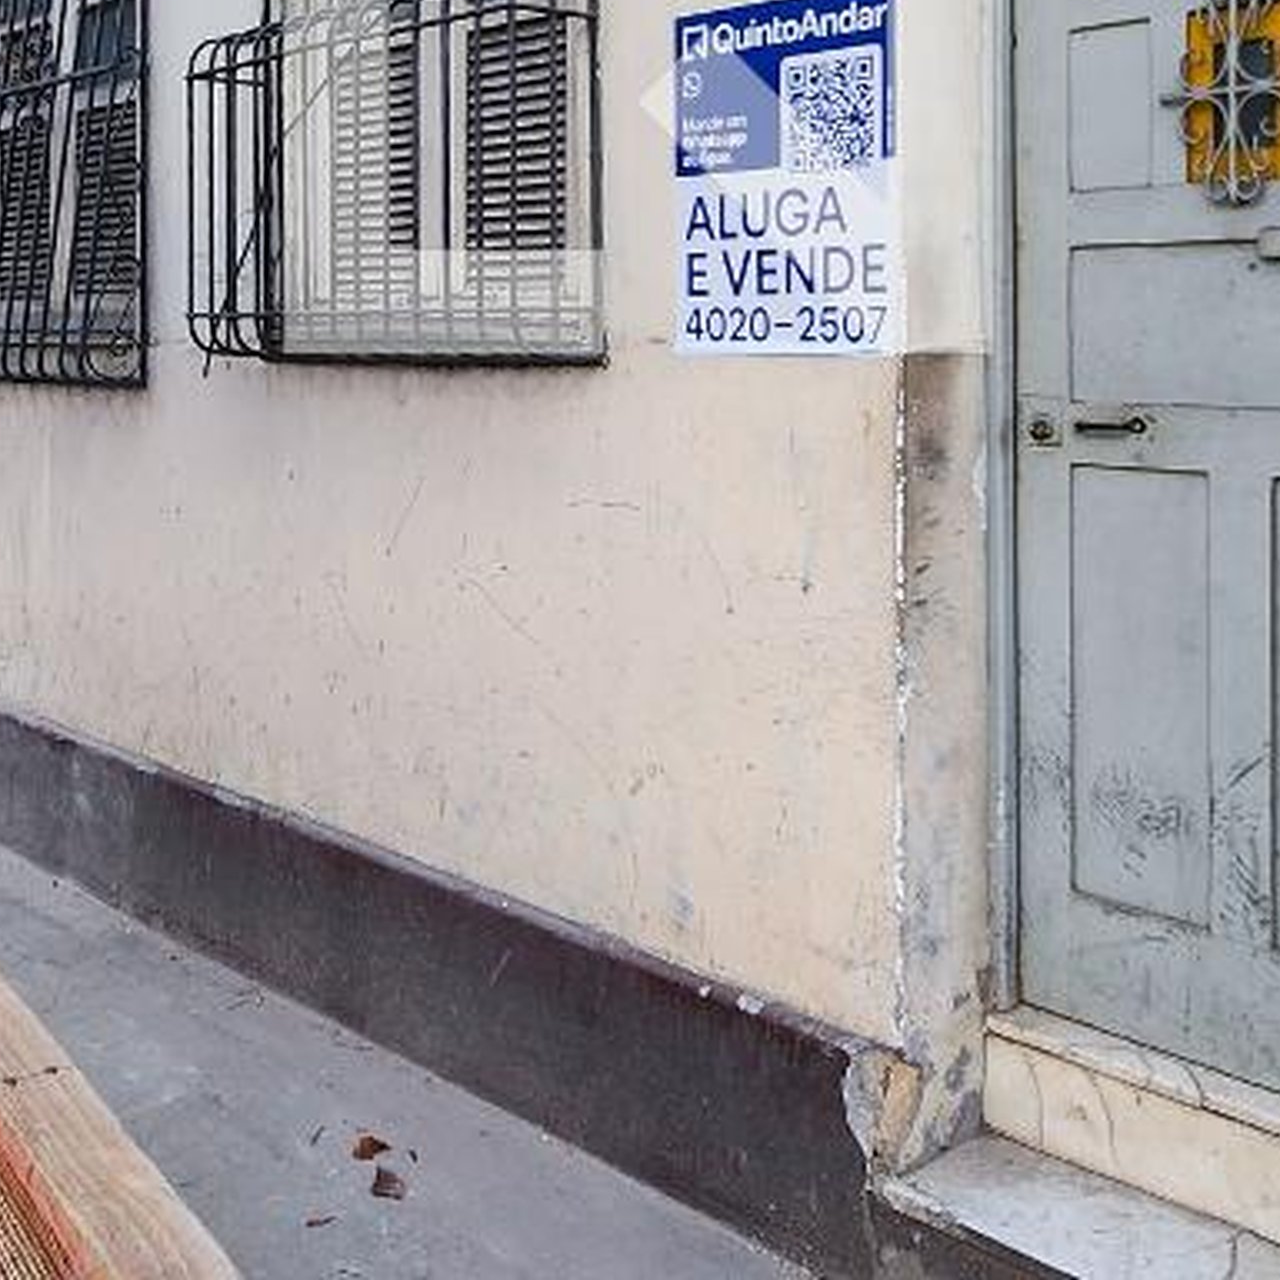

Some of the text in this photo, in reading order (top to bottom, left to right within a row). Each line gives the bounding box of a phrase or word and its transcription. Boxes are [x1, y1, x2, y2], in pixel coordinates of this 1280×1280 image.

[712, 1, 888, 54] QuintoAndar
[686, 186, 847, 240] ALUGA
[687, 244, 887, 297] E VENDE
[685, 306, 888, 344] 4020-2507
